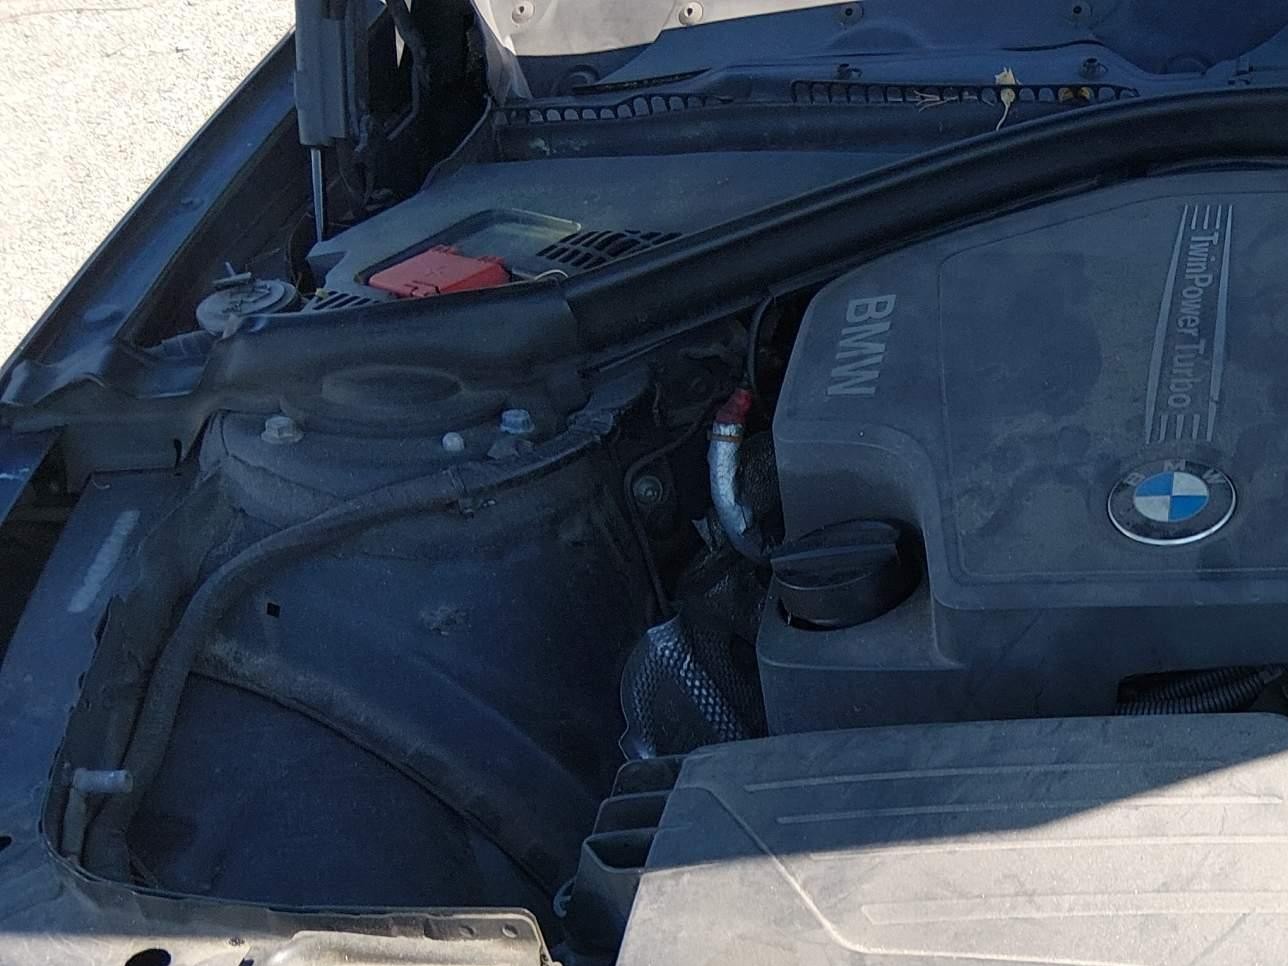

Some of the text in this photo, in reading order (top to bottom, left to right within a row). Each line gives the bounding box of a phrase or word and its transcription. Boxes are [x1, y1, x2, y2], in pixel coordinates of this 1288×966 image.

[828, 294, 897, 395] BMW
[1167, 231, 1219, 409] TwinPower Turbo
[1122, 459, 1227, 487] BMW
